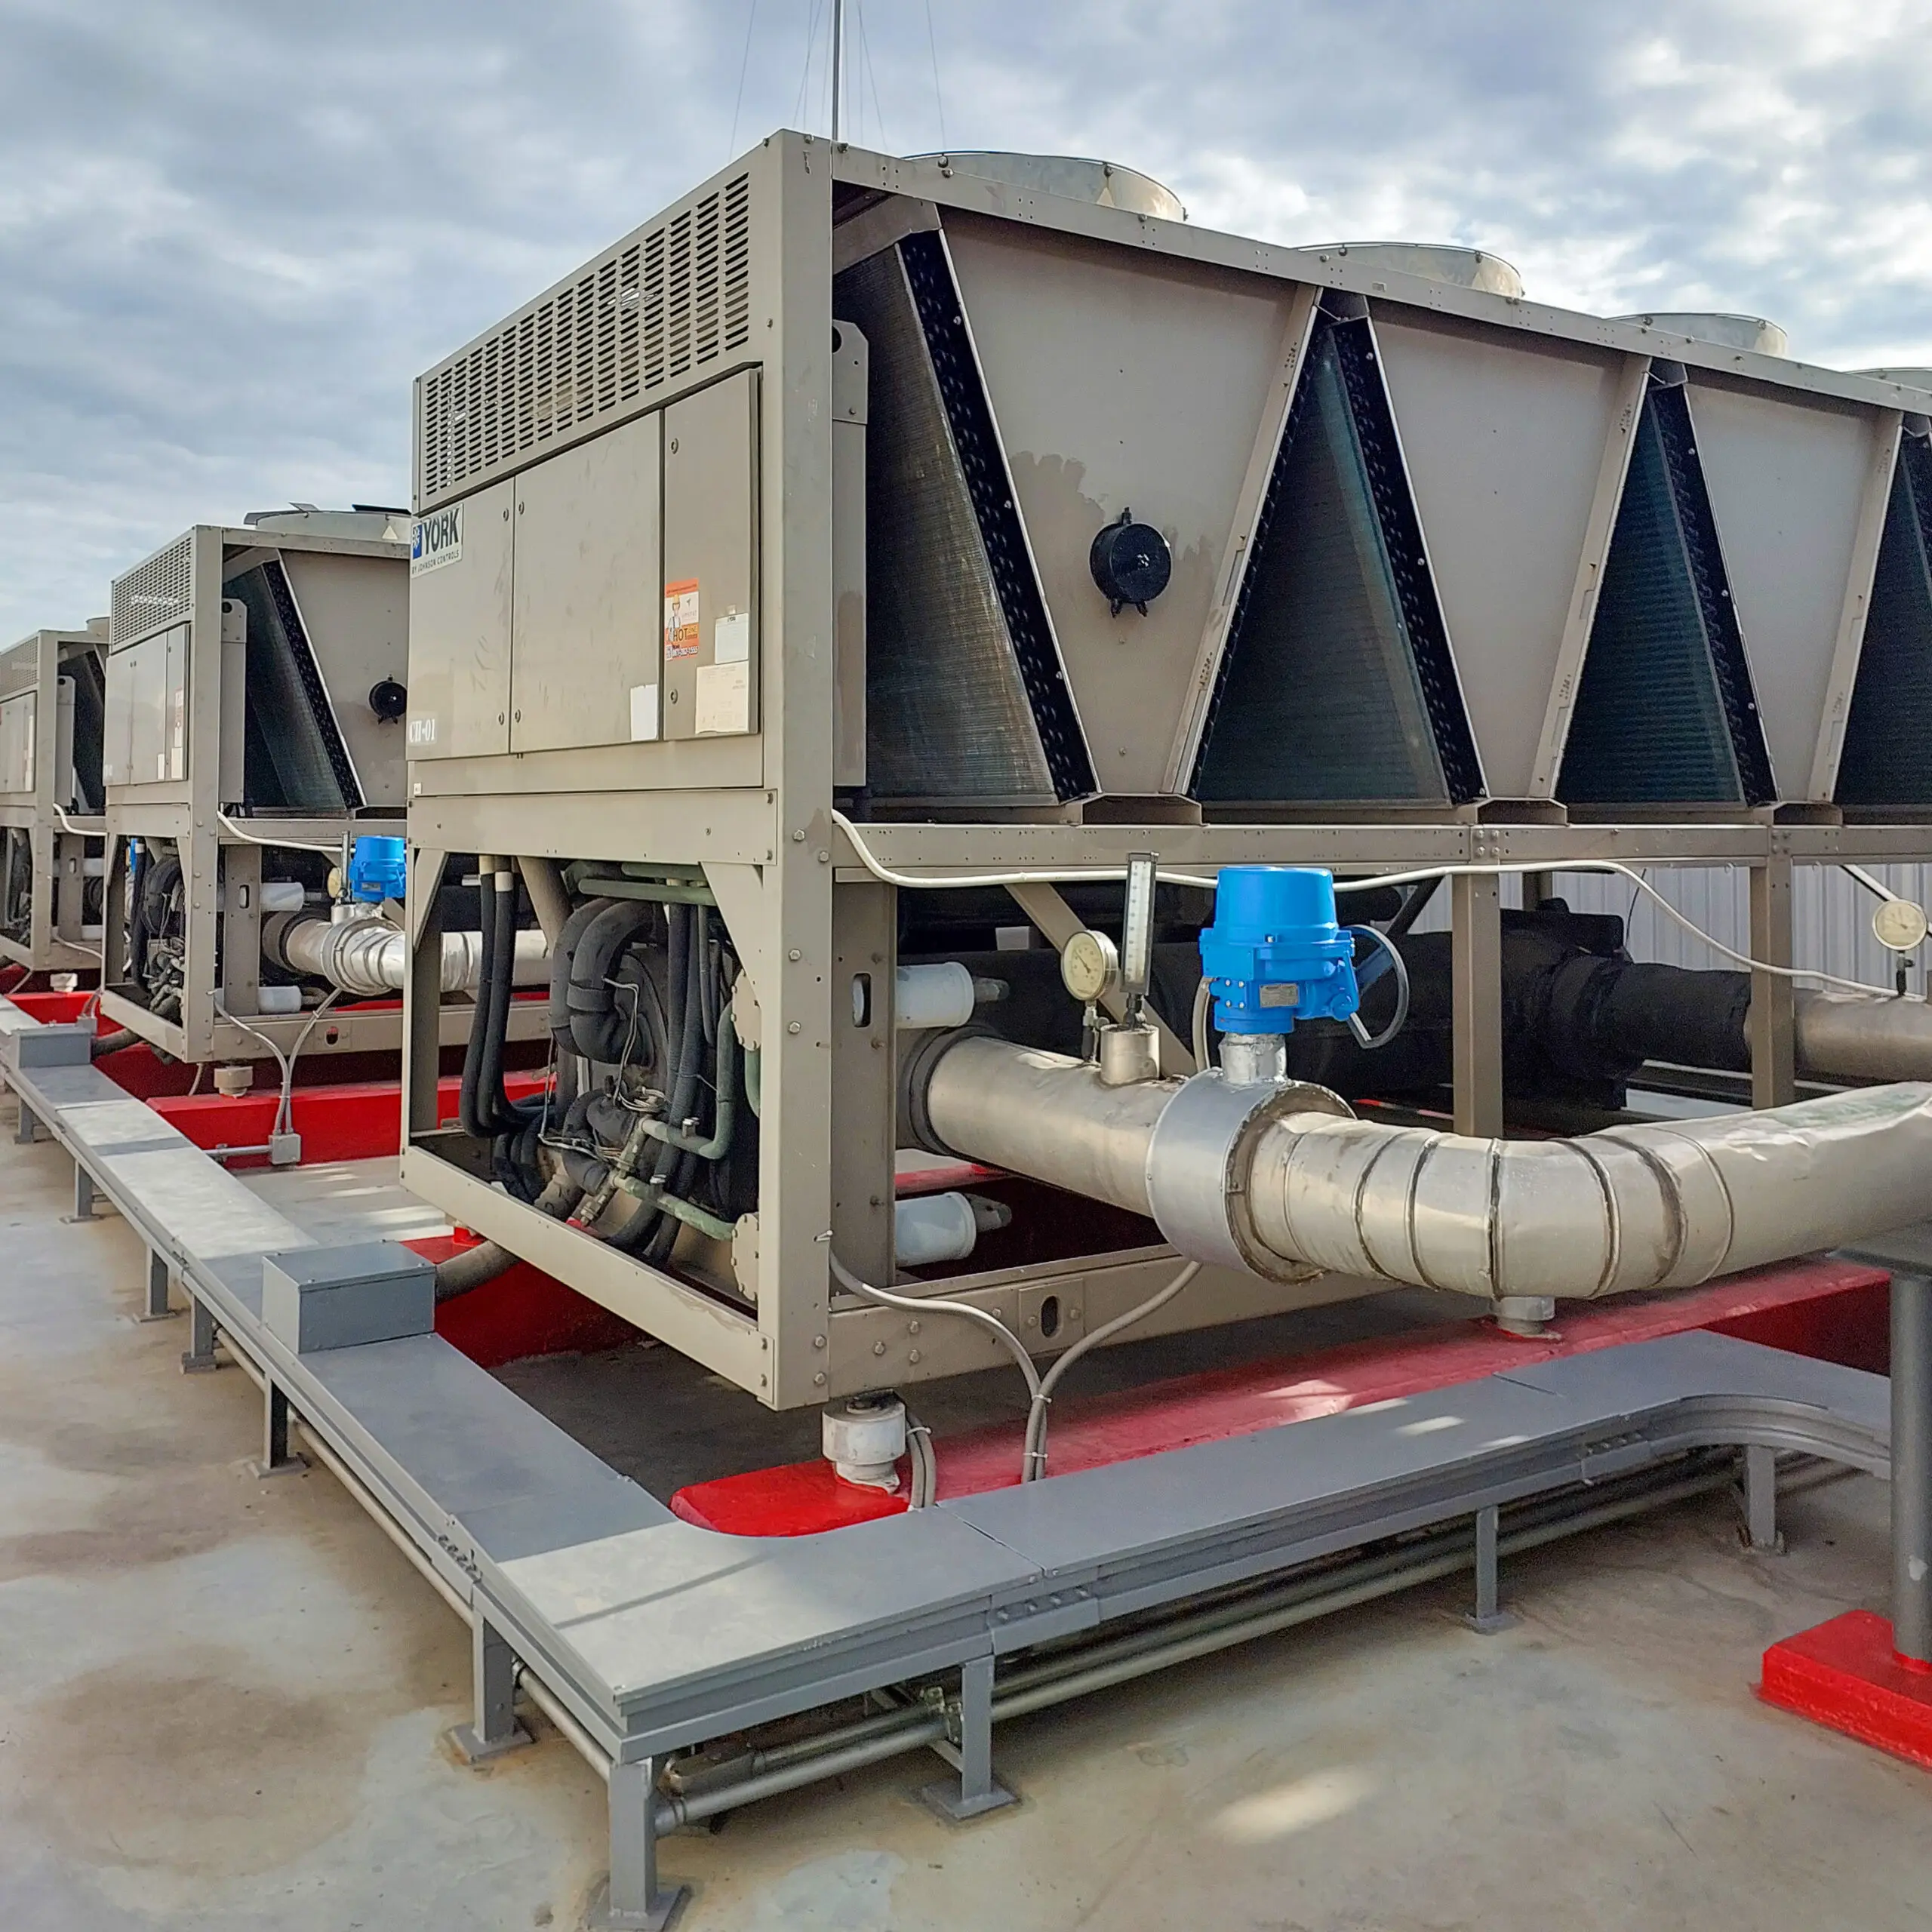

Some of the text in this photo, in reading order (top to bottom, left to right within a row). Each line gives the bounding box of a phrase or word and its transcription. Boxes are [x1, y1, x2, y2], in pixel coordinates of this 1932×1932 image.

[423, 507, 460, 555] YORK
[437, 549, 460, 565] CONTROLS
[672, 627, 688, 642] HOT
